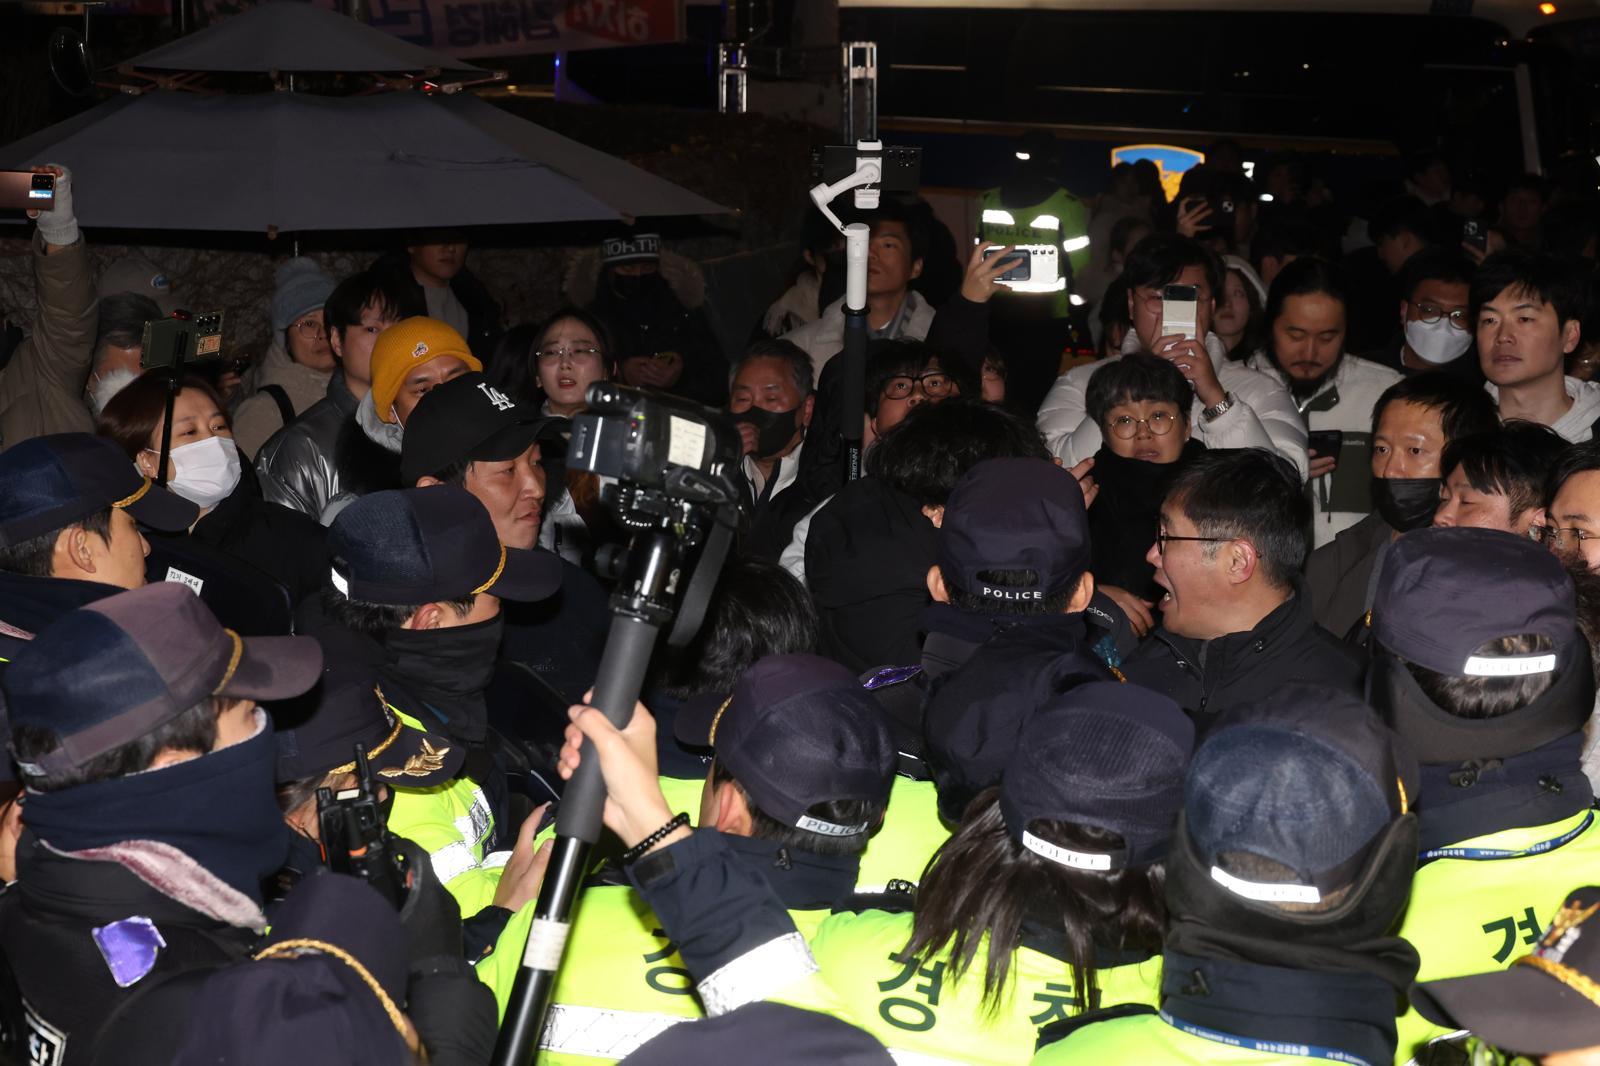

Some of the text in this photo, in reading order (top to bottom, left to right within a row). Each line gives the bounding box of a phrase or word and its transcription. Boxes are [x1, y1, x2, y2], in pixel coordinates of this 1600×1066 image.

[985, 225, 1042, 239] POLICE
[476, 382, 515, 411] LA
[983, 587, 1043, 600] POLICE
